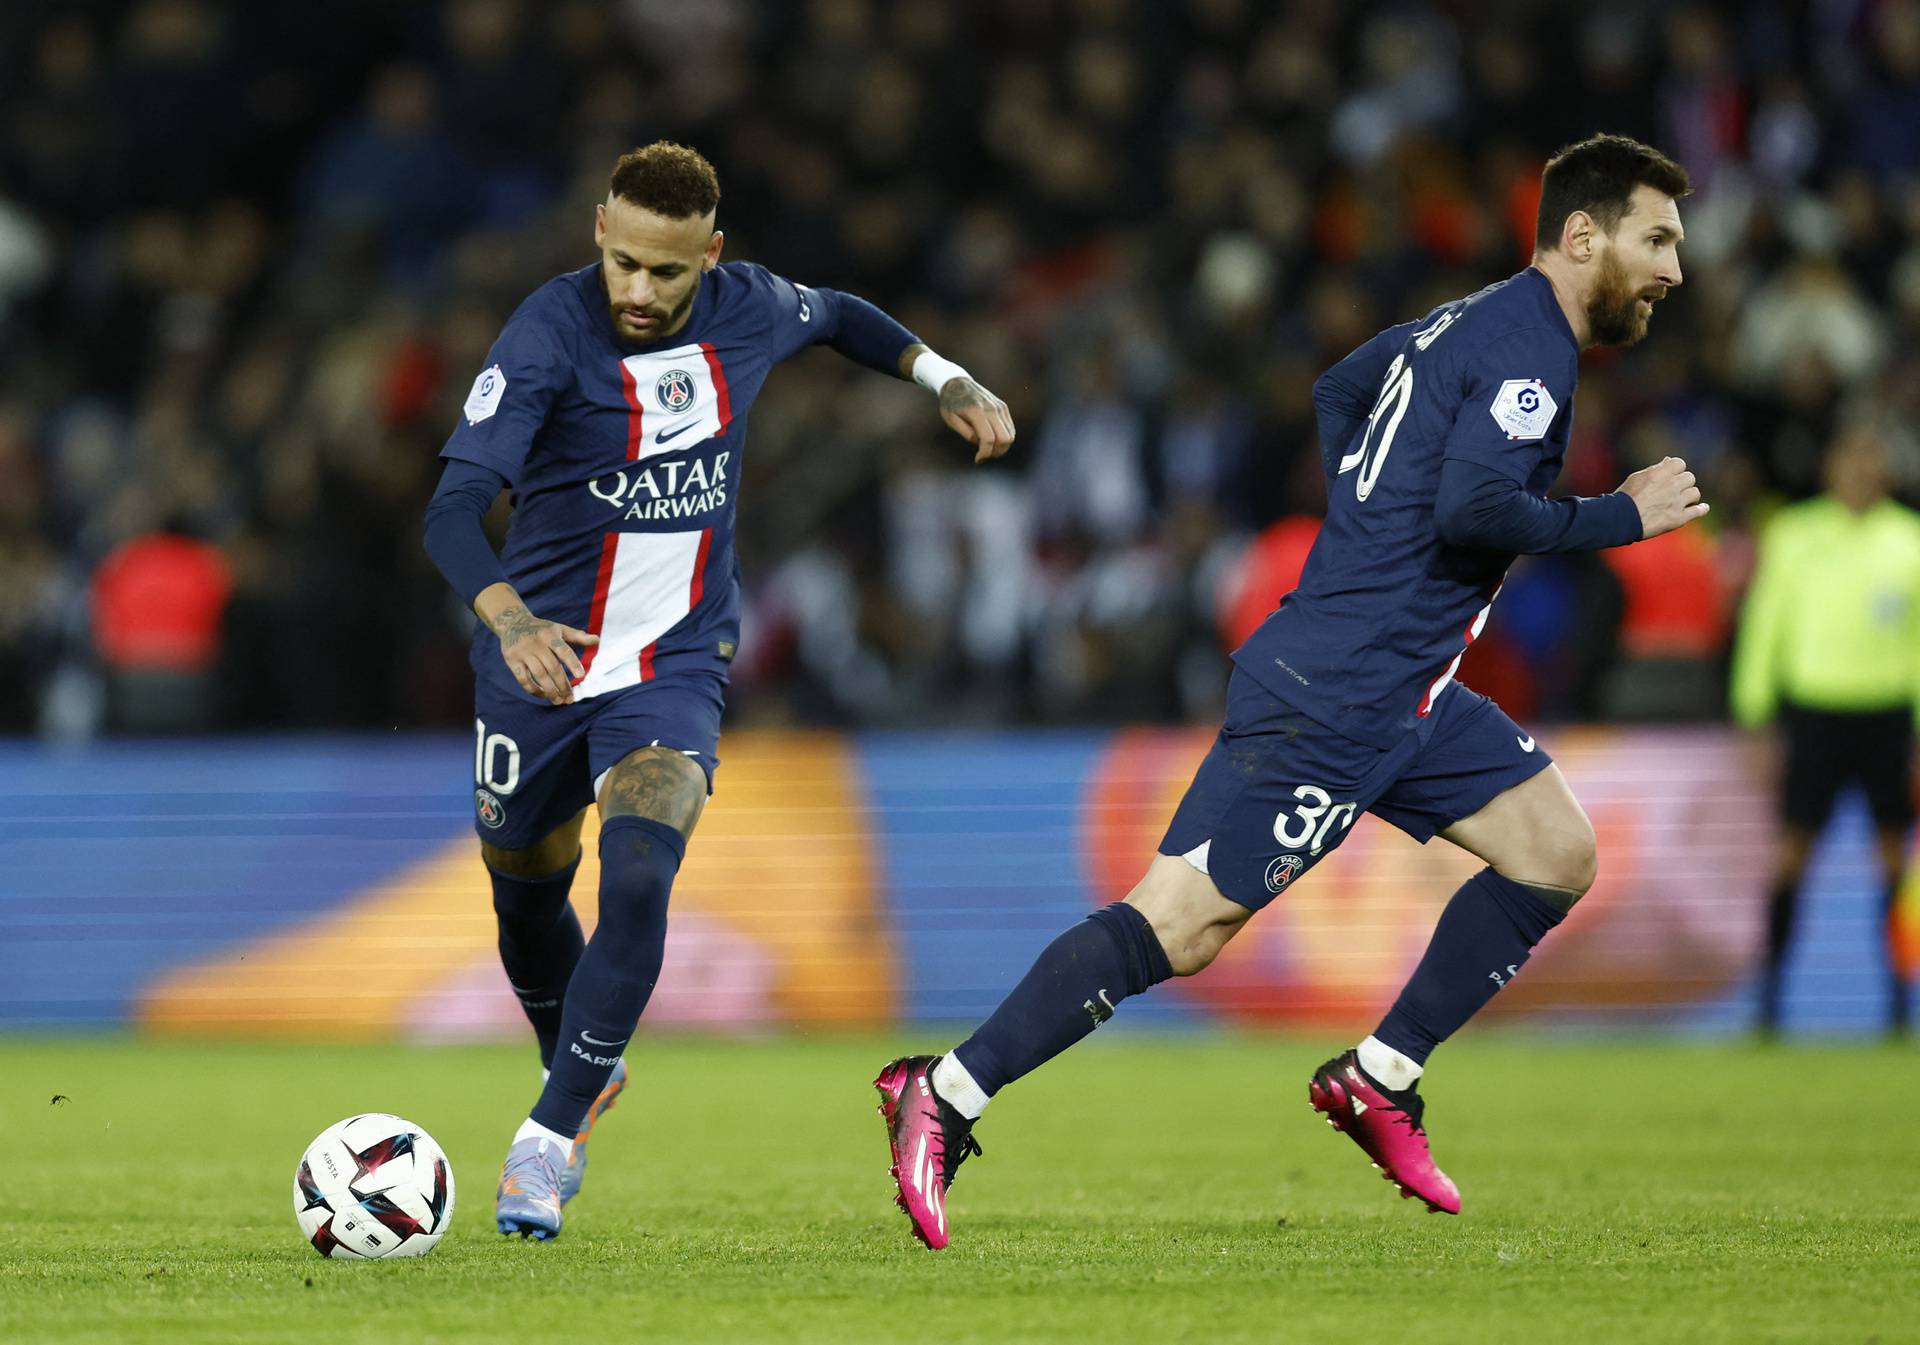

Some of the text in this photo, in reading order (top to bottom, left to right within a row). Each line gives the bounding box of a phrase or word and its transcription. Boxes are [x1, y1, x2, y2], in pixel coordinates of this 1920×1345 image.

[660, 372, 686, 387] PARIS
[588, 451, 730, 508] QATAR
[624, 483, 726, 520] AIRWAYS
[476, 718, 520, 795] 10
[1273, 785, 1357, 856] 30
[571, 1042, 621, 1067] PARIS
[323, 1151, 339, 1179] KIPSTA
